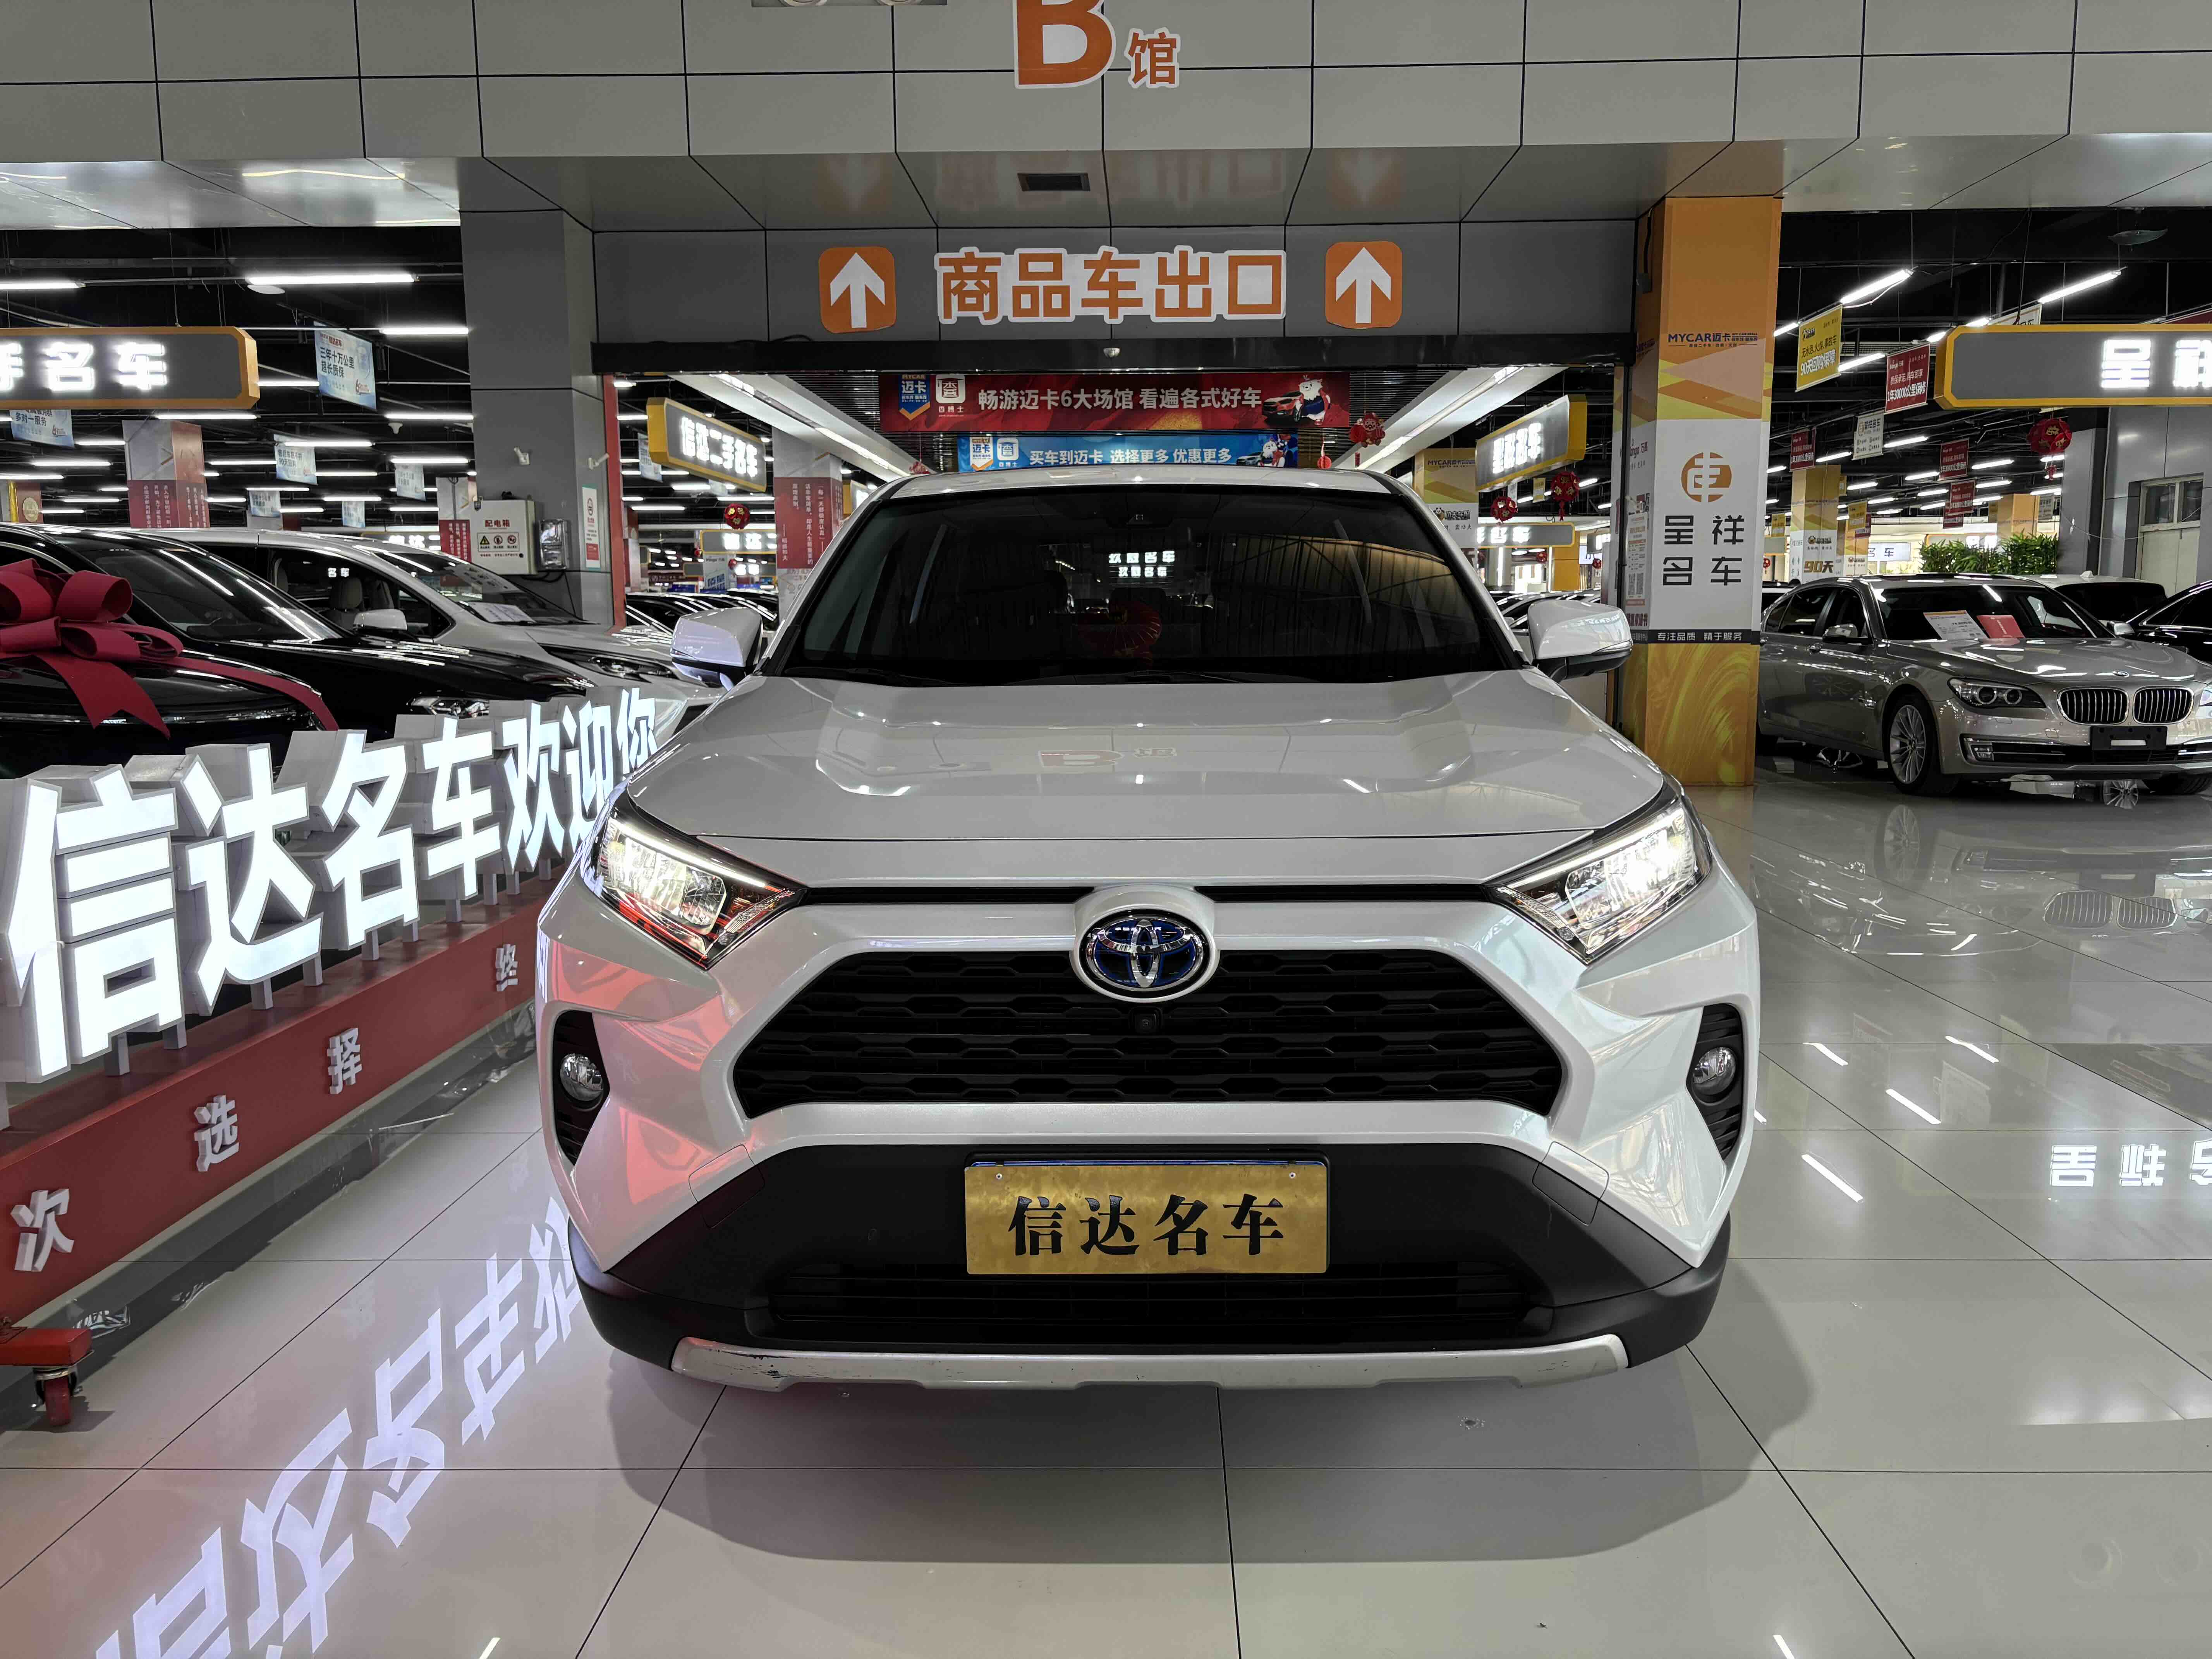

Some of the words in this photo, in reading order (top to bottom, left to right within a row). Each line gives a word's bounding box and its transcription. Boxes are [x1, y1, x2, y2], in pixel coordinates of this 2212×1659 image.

[936, 249, 1285, 324] 商品车出口
[320, 347, 354, 369] 三年十万公里
[902, 381, 927, 393] 迈卡
[978, 388, 1134, 410] 畅游迈卡6大场馆
[1139, 388, 1262, 409] 看遍各式好车
[972, 444, 991, 453] 迈卡
[1030, 450, 1103, 465] 买车到迈卡
[1110, 449, 1169, 464] 选择更多
[1173, 448, 1232, 463] 优惠更多
[1664, 515, 1745, 545] 呈祥
[1662, 556, 1742, 586] 名车
[1803, 560, 1834, 574] 90天
[1657, 632, 1696, 641] 专注品质
[1704, 632, 1742, 641] 精于服务
[6, 685, 658, 1083] 信达名车欢迎你
[1008, 1193, 1283, 1256] 信达名车
